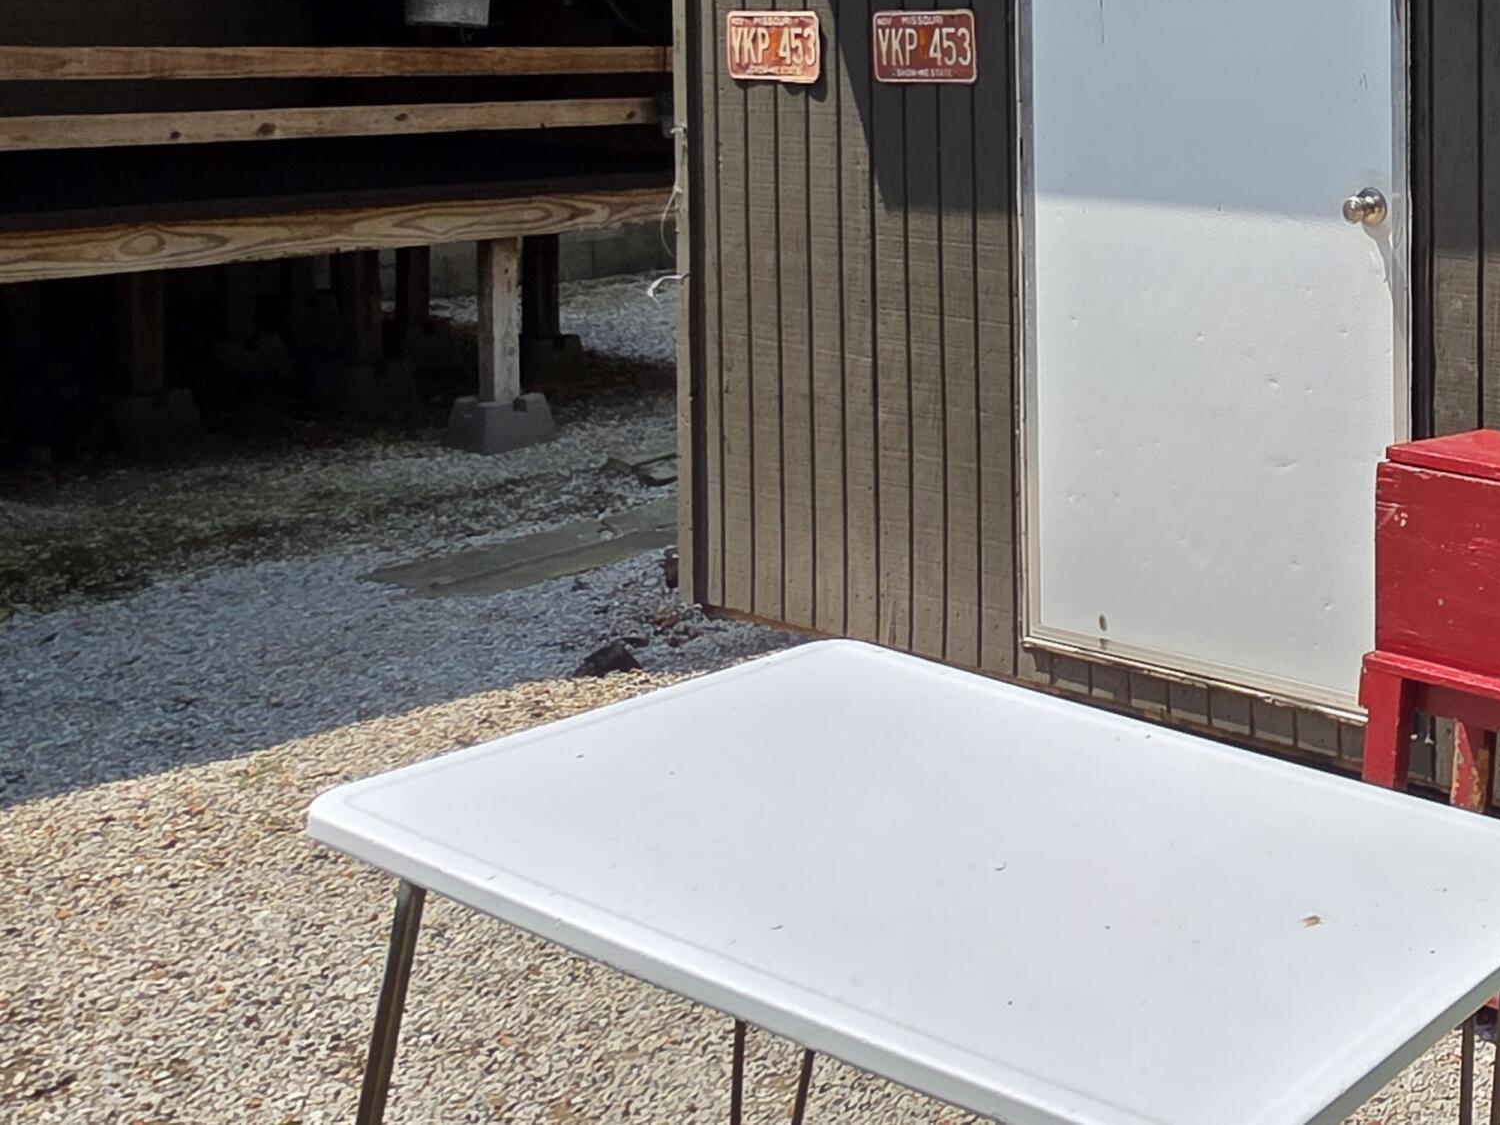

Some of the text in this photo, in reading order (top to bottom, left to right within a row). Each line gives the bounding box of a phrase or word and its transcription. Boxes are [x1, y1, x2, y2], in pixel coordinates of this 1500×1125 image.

[731, 26, 816, 66] YKP 453
[878, 27, 972, 66] YKP 453
